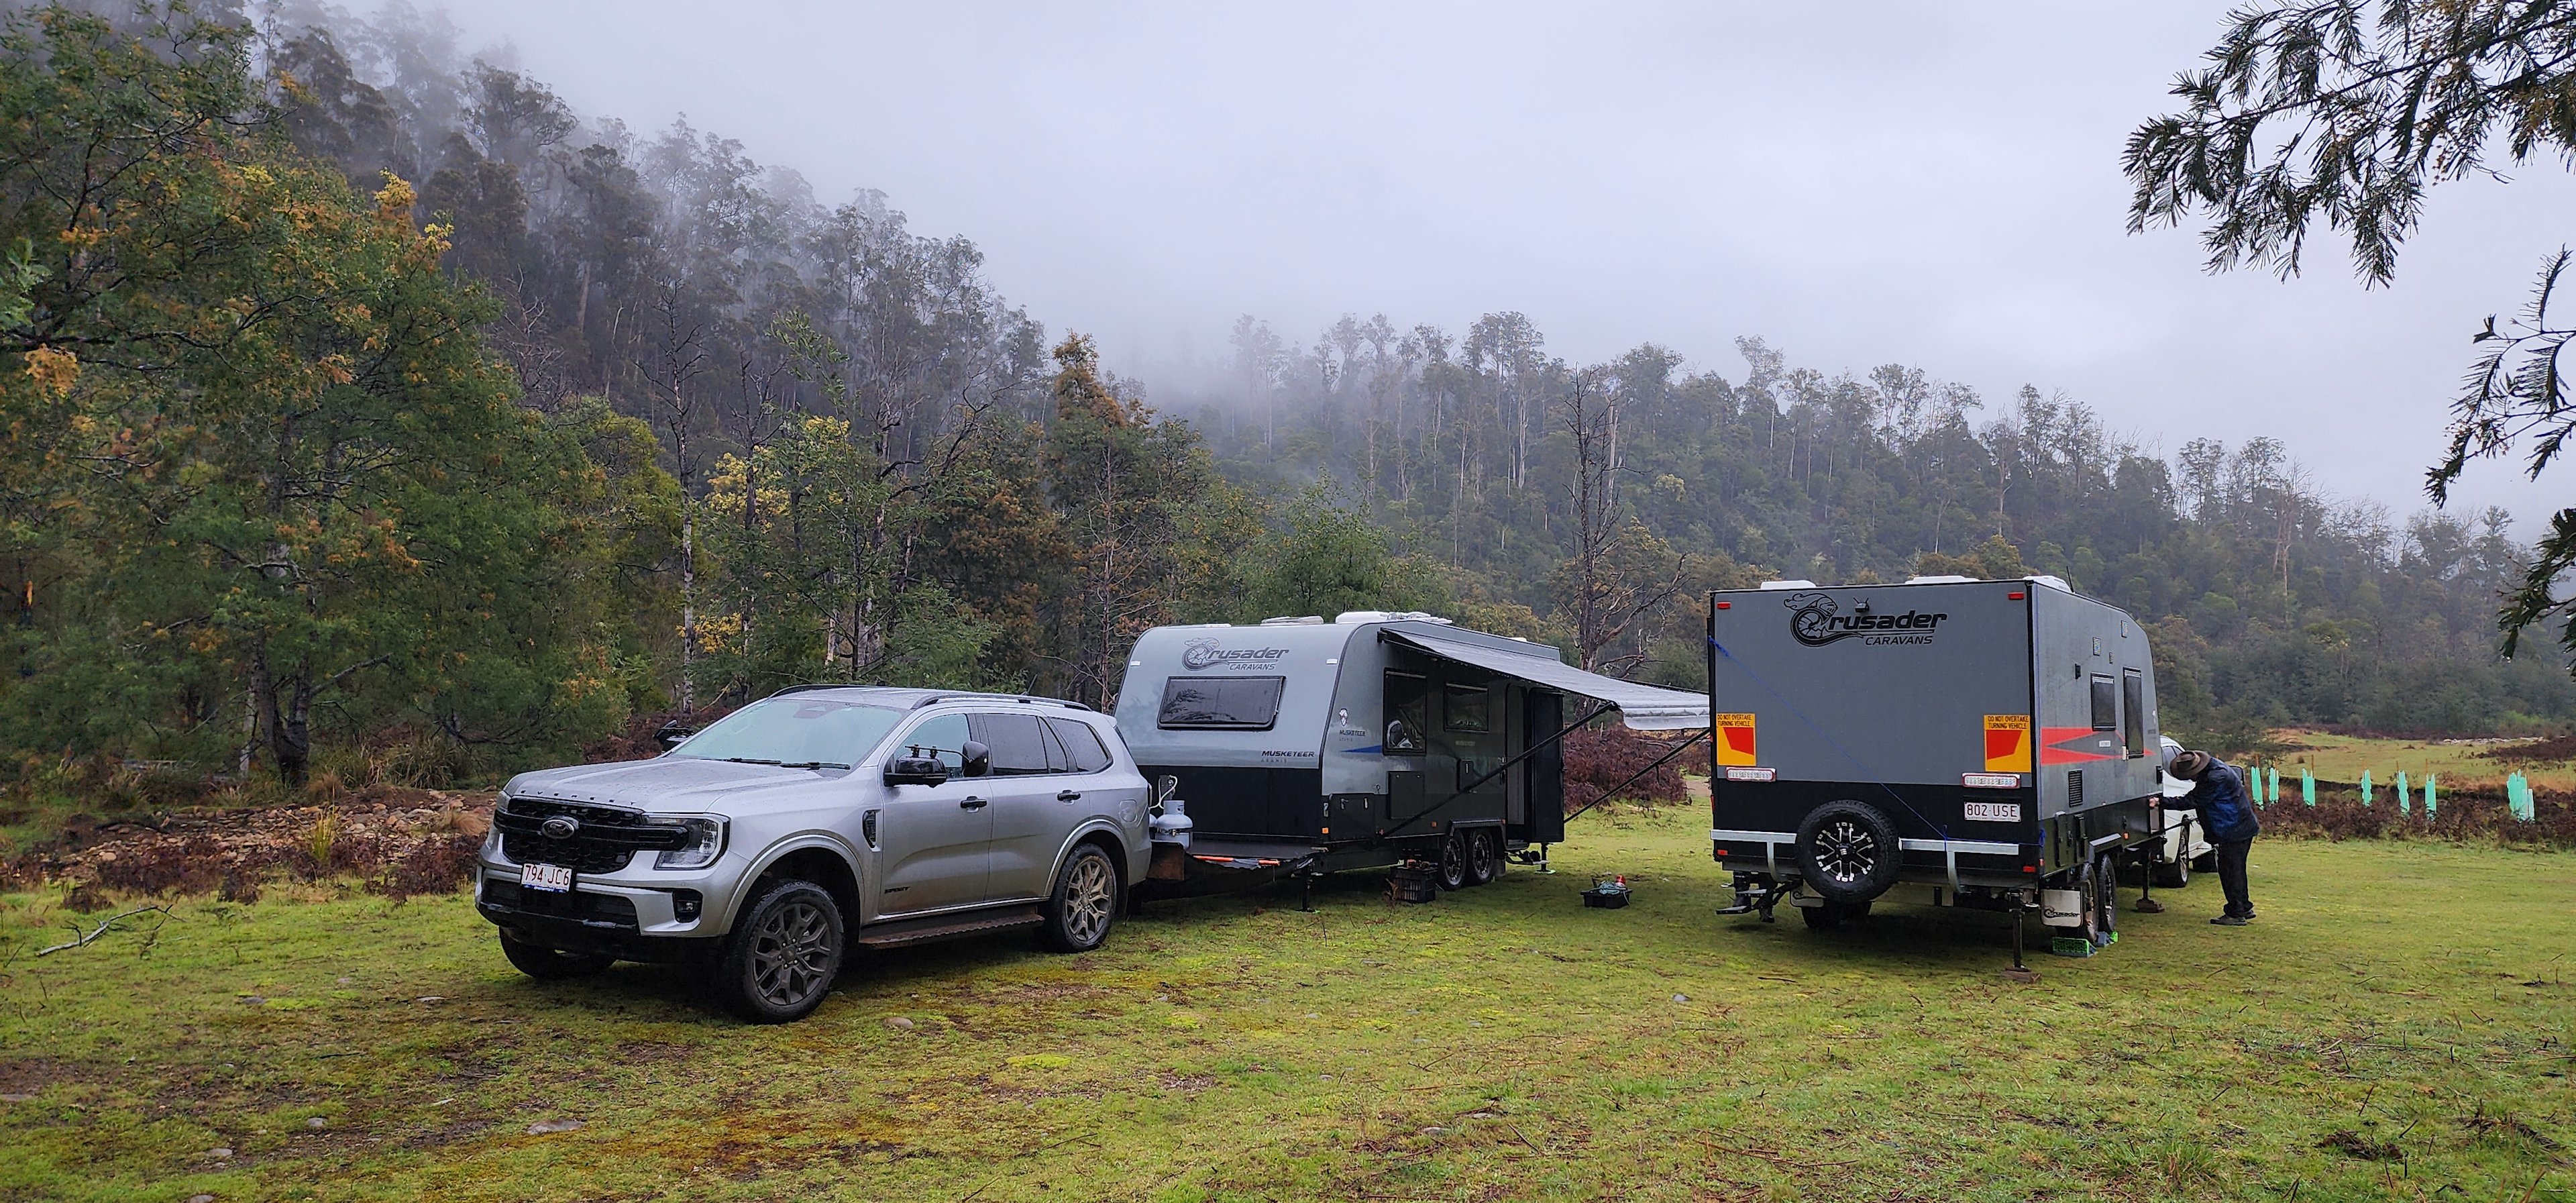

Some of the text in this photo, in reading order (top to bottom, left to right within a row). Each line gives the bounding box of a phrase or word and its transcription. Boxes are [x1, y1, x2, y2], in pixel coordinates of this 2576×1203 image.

[1790, 607, 1947, 647] Crusader
[1866, 636, 1933, 645] CARAVANS
[1182, 645, 1289, 671] Crusader
